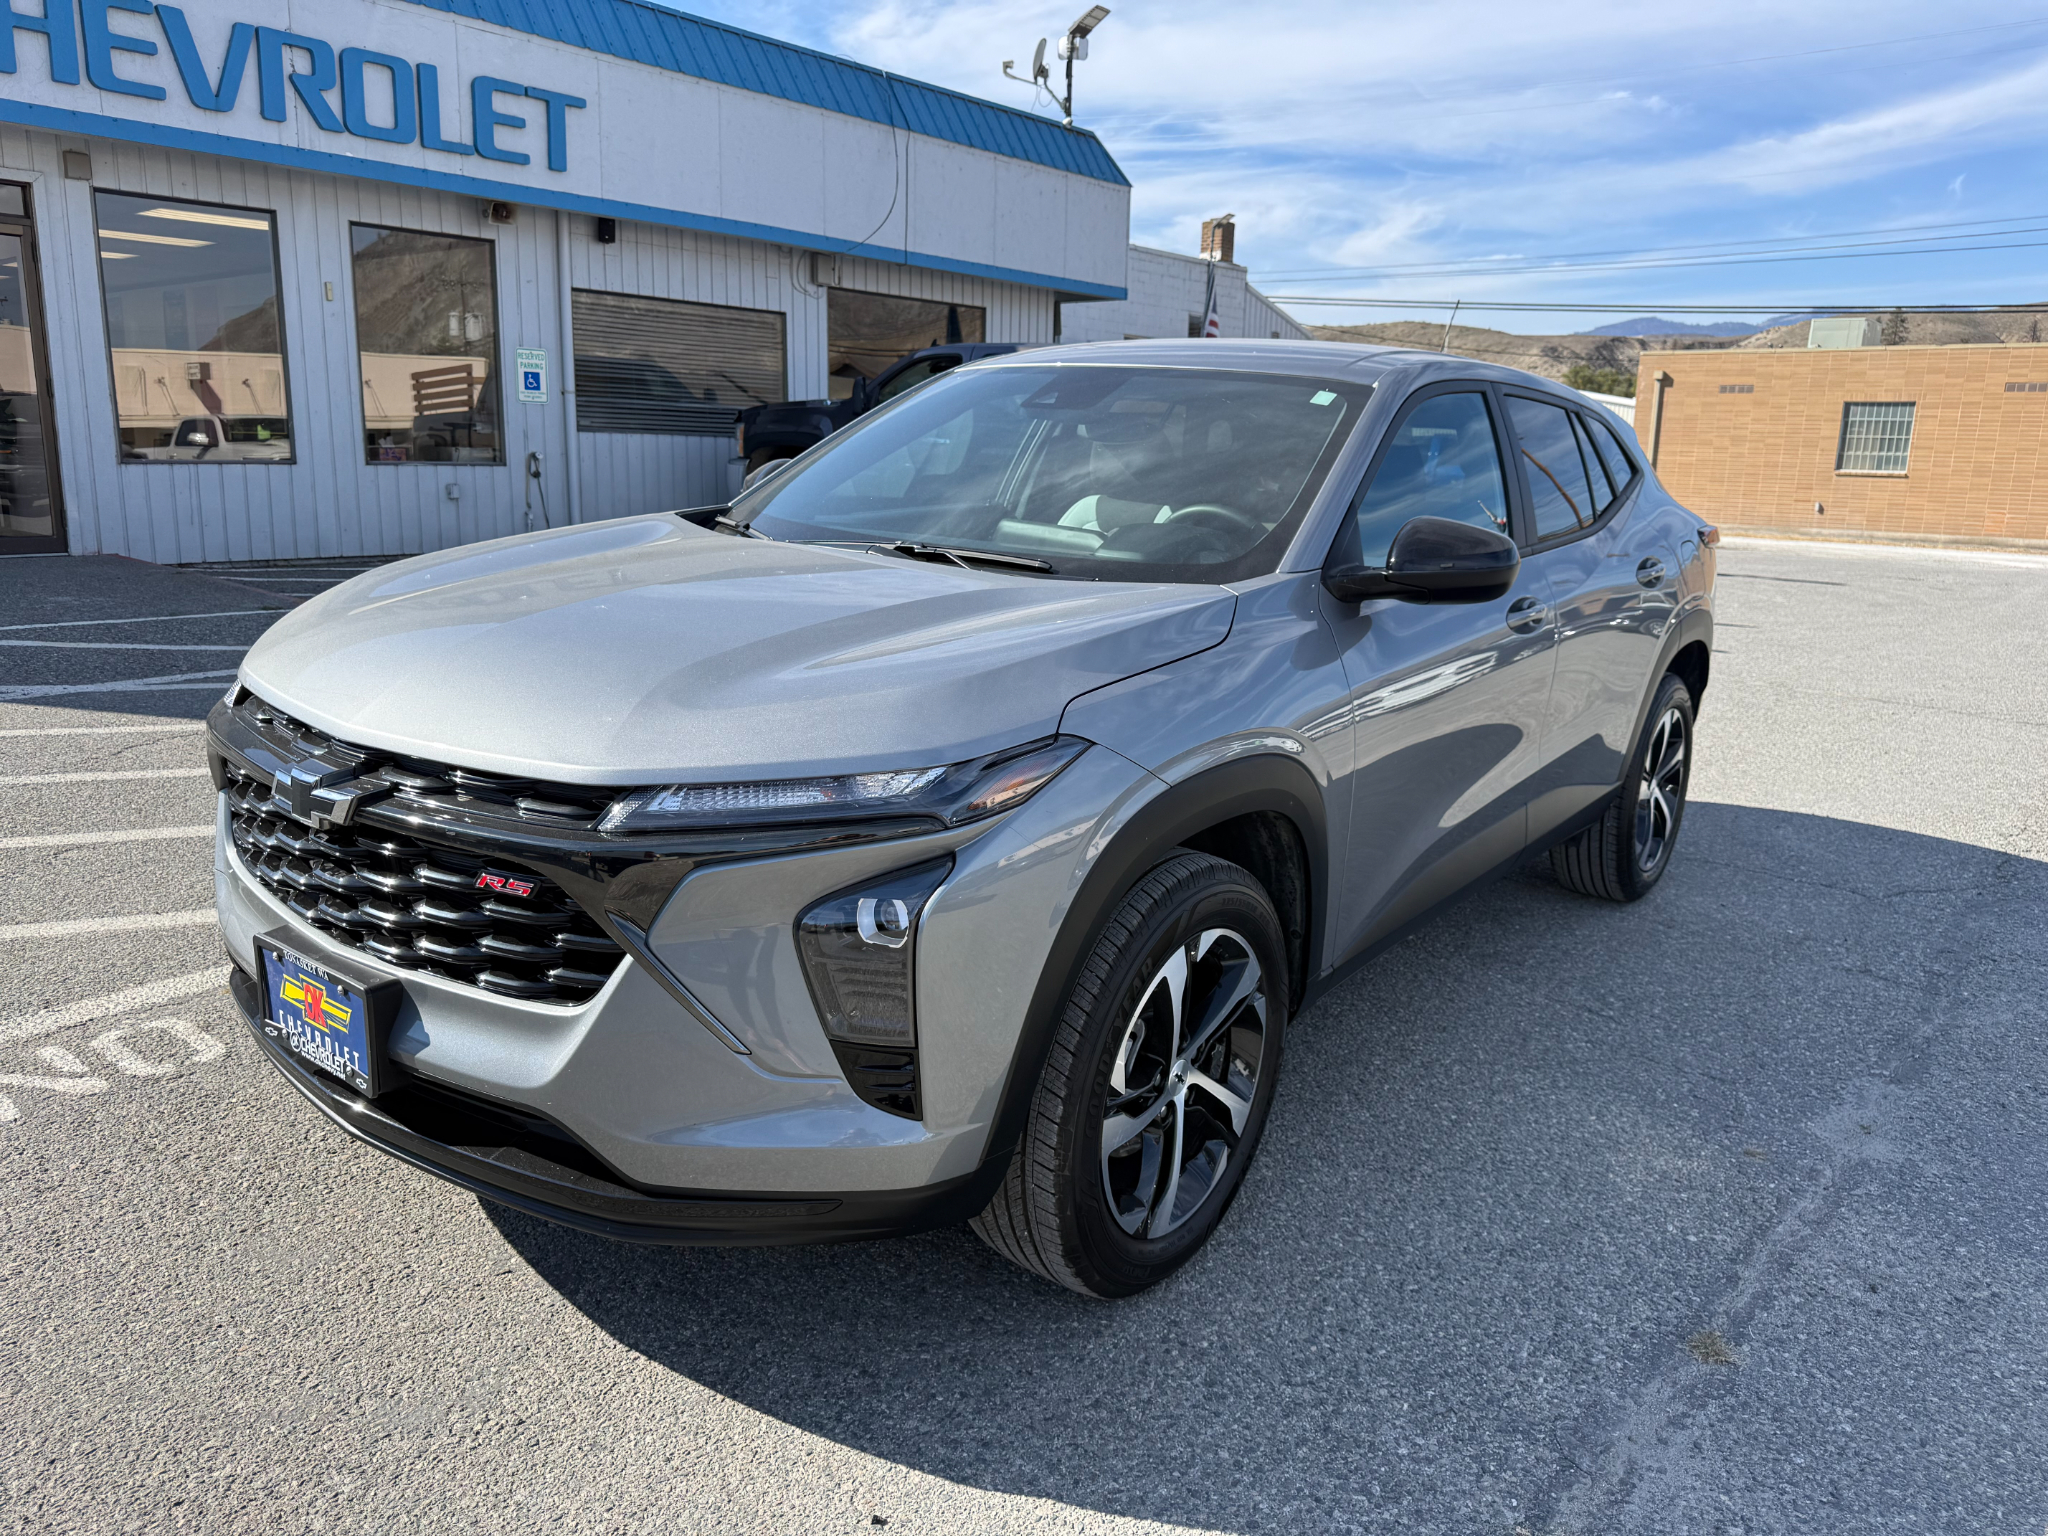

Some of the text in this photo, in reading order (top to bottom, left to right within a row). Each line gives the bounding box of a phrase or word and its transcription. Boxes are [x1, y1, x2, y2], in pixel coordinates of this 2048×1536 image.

[518, 352, 545, 362] RESERVED
[520, 361, 544, 371] PARKING
[475, 873, 534, 897] RS
[317, 967, 329, 981] WA
[303, 982, 327, 1028] OK
[301, 1036, 346, 1072] CHEVROLET
[1085, 956, 1153, 1138] GOODYEAR
